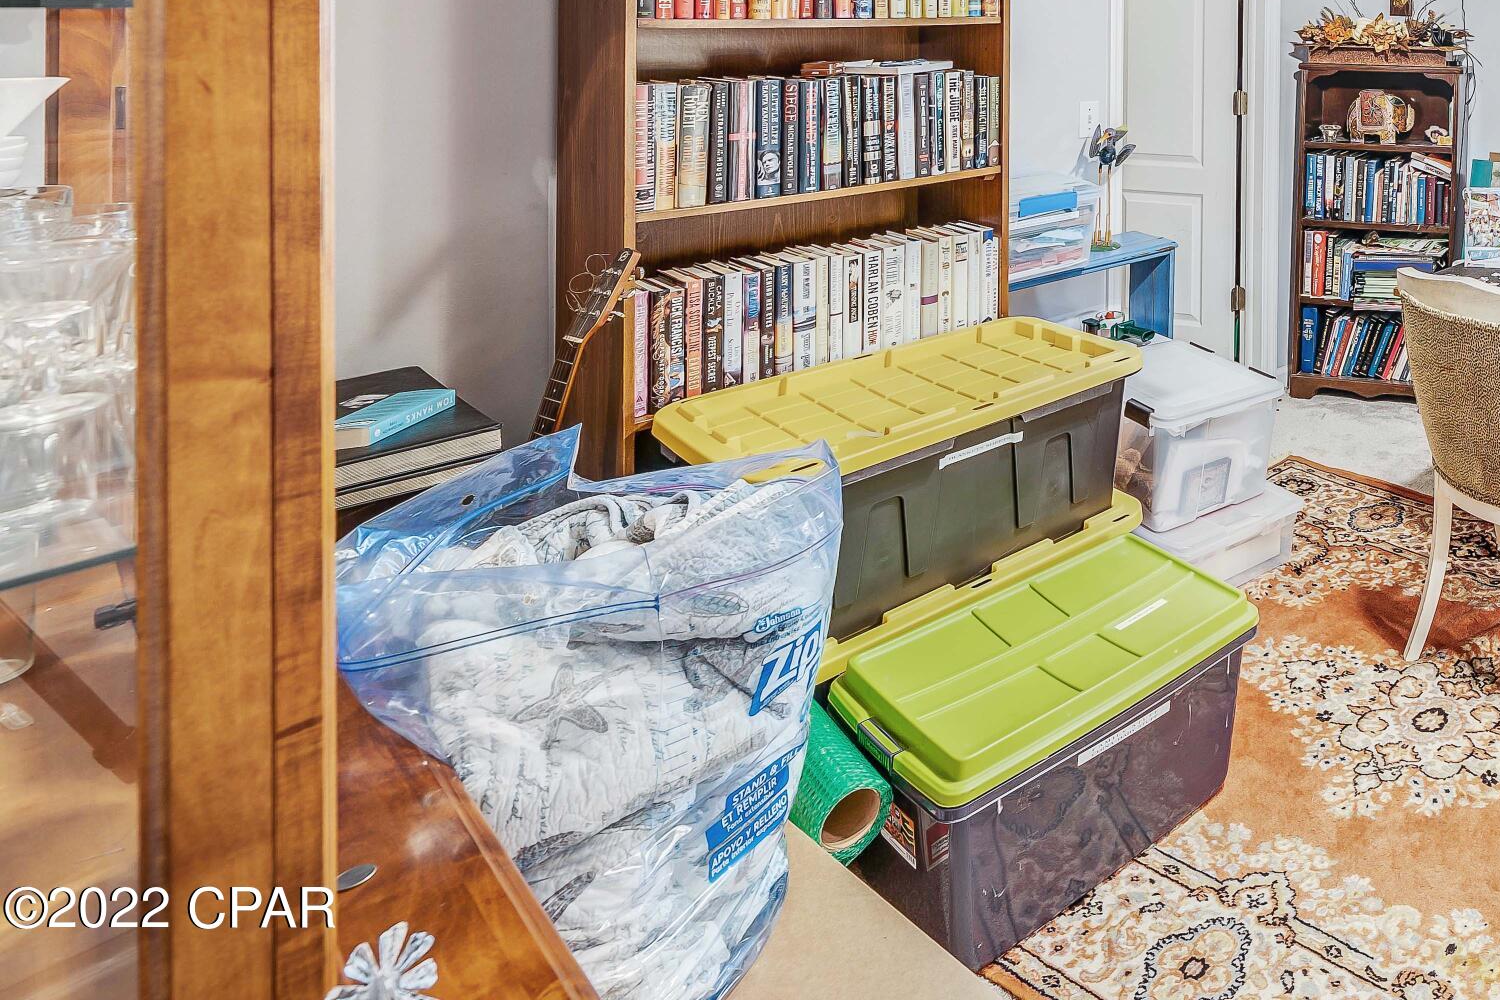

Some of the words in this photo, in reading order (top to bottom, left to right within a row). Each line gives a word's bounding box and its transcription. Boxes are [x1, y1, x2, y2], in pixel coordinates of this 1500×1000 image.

[949, 77, 960, 93] THE
[683, 95, 697, 130] FOLLETT
[696, 101, 708, 122] KEN
[784, 84, 797, 122] SIEGE
[949, 95, 960, 123] JUDGE
[867, 256, 878, 295] HARLAN
[672, 297, 682, 317] DICK
[689, 291, 700, 307] LISA
[867, 296, 878, 328] COBEN
[670, 319, 683, 353] FRANCIS
[689, 310, 701, 352] SCOTTOLINE
[707, 336, 717, 360] DEEPEST
[689, 357, 701, 390] EXPOSED
[707, 362, 716, 383] SECRET
[406, 405, 433, 423] HANKS
[437, 395, 453, 408] TOM
[766, 609, 800, 625] Johnson
[732, 773, 766, 806] STAND
[770, 765, 779, 776] &
[721, 812, 734, 829] ET
[737, 777, 777, 813] REMPLIR
[745, 790, 774, 818] extensible
[712, 835, 743, 869] APOYO
[745, 827, 752, 836] Y
[754, 795, 787, 832] RELLENO
[711, 860, 730, 878] Parte
[732, 837, 754, 860] interior
